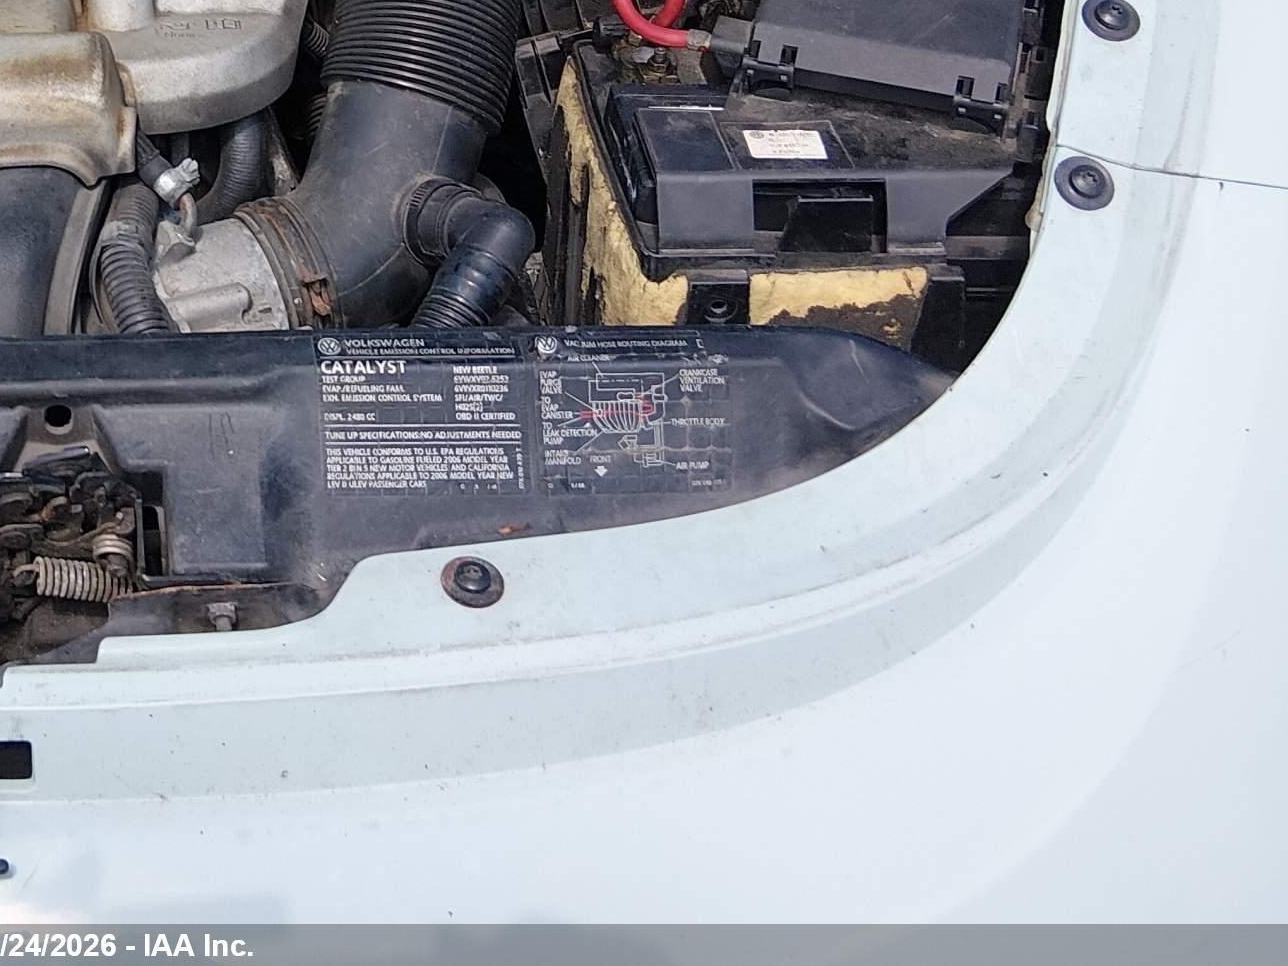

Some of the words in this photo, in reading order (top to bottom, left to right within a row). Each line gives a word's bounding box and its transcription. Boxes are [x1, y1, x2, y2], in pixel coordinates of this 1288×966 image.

[344, 339, 425, 347] VOLKSWAGEN
[617, 339, 650, 348] ROUTING
[651, 339, 688, 348] DIAGRAM
[321, 361, 407, 374] CATALYST
[453, 366, 471, 374] NEW
[472, 366, 497, 374] BEETLE
[322, 375, 338, 384] TEST
[340, 375, 366, 384] GROUP
[679, 376, 725, 385] VENTILATION
[680, 384, 703, 392] VALVE
[342, 394, 376, 402] EMISSION
[378, 394, 412, 402] CONTROL
[413, 394, 442, 402] SYSTEM
[541, 396, 552, 404] TO
[366, 413, 376, 421] CC
[456, 413, 472, 421] OBD
[481, 413, 515, 421] CERTIFIED
[541, 411, 573, 420] CANISTER
[542, 421, 552, 429] TO
[325, 431, 345, 439] TUNE
[347, 431, 358, 439] UP
[434, 431, 490, 439] ADJUSTMENTS
[492, 431, 522, 439] NEEDED
[543, 428, 560, 437] LEAK
[561, 428, 598, 437] DETECTION
[544, 436, 563, 445] PUMP
[326, 448, 341, 456] THIS
[343, 448, 370, 456] VEHICLE
[372, 448, 412, 456] CONFORMS
[413, 448, 424, 456] TO
[440, 448, 455, 456] EPA
[456, 448, 505, 456] REGULATIONS
[327, 456, 366, 464] APPLICABLE
[368, 456, 378, 464] TO
[380, 456, 414, 464] GASOLINE
[416, 456, 442, 464] FUELED
[443, 456, 461, 464] 2006
[463, 456, 488, 464] MODEL
[489, 456, 508, 464] YEAR
[589, 455, 611, 463] FRONT
[327, 464, 341, 472] TIER
[342, 464, 348, 472] 2
[369, 464, 387, 472] NEW
[389, 464, 415, 472] MOTOR
[416, 464, 448, 472] VEHICLES
[451, 464, 466, 472] AND
[468, 464, 510, 472] CALIFORNIA
[689, 461, 710, 469] PUMP
[327, 472, 375, 480] REGULATIONS
[377, 472, 417, 480] APPLICABLE
[418, 472, 430, 480] TO
[450, 472, 475, 480] MODEL
[477, 472, 496, 480] YEAR
[497, 472, 514, 480] NEW
[327, 480, 340, 489] LEV
[349, 480, 367, 489] ULEV
[369, 480, 407, 489] PASSENGER
[409, 480, 427, 489] CARS
